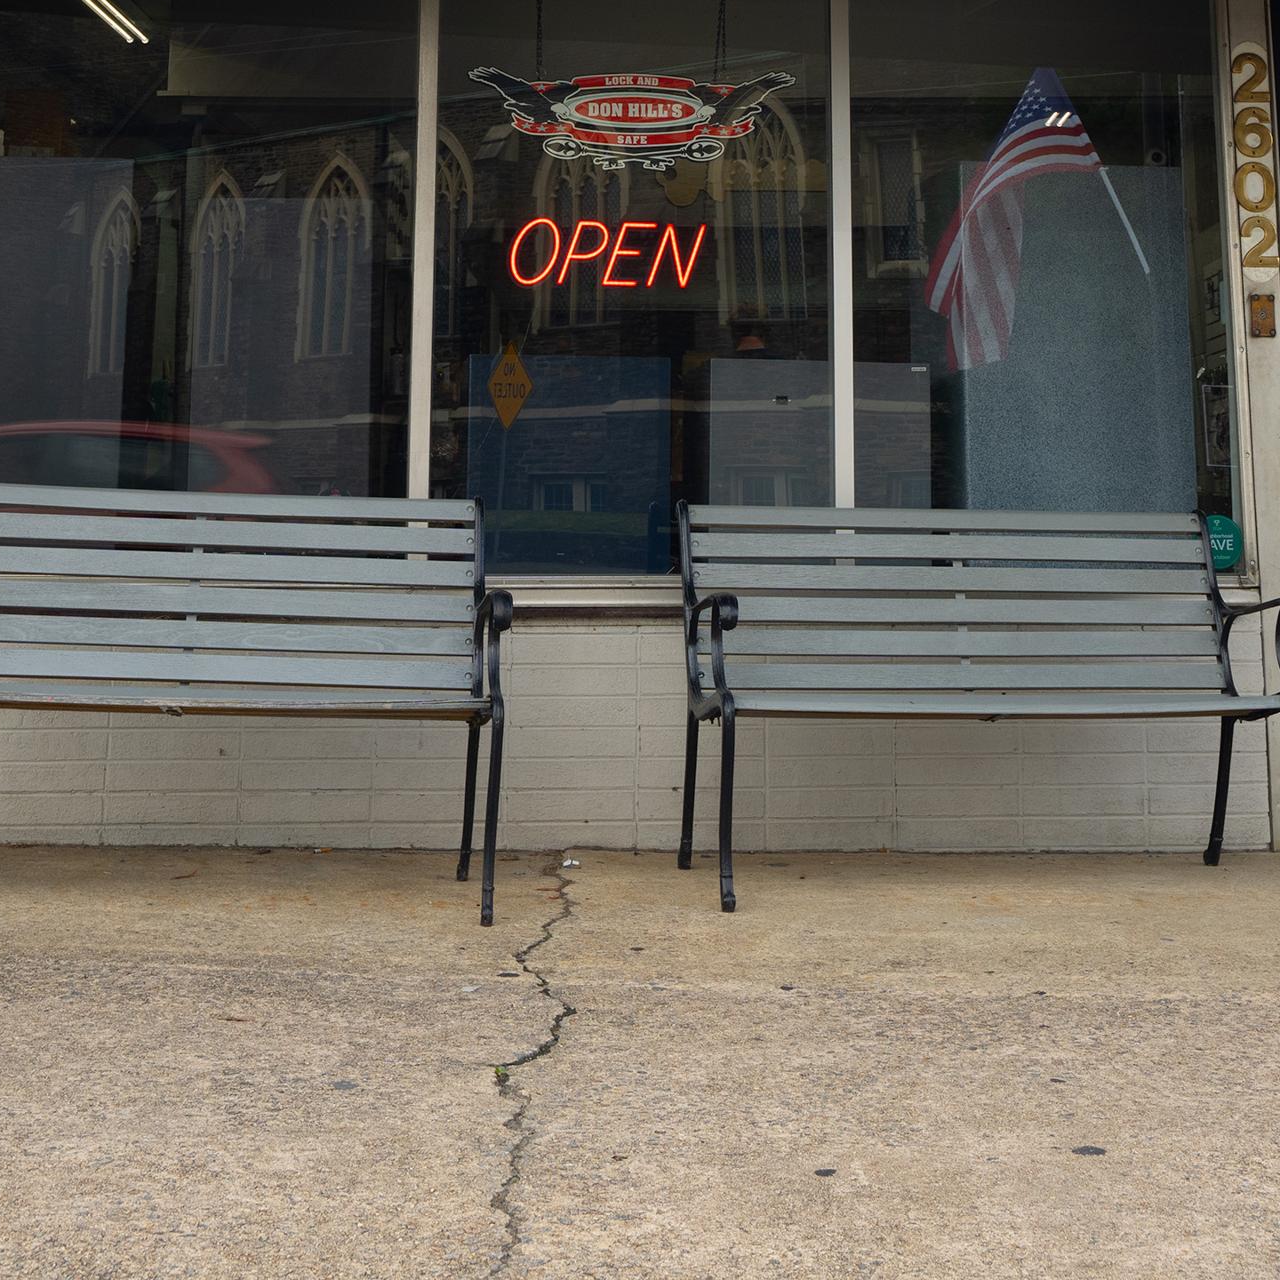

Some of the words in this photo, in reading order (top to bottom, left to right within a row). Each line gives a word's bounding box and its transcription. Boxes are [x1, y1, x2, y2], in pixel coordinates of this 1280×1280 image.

[604, 76, 634, 86] LOCK
[636, 76, 659, 86] AND
[587, 102, 623, 117] DON
[627, 103, 683, 118] HILL'S
[617, 135, 648, 145] SAFE
[1231, 52, 1280, 268] 2602
[509, 217, 707, 289] OPEN
[1210, 539, 1234, 551] AVE
